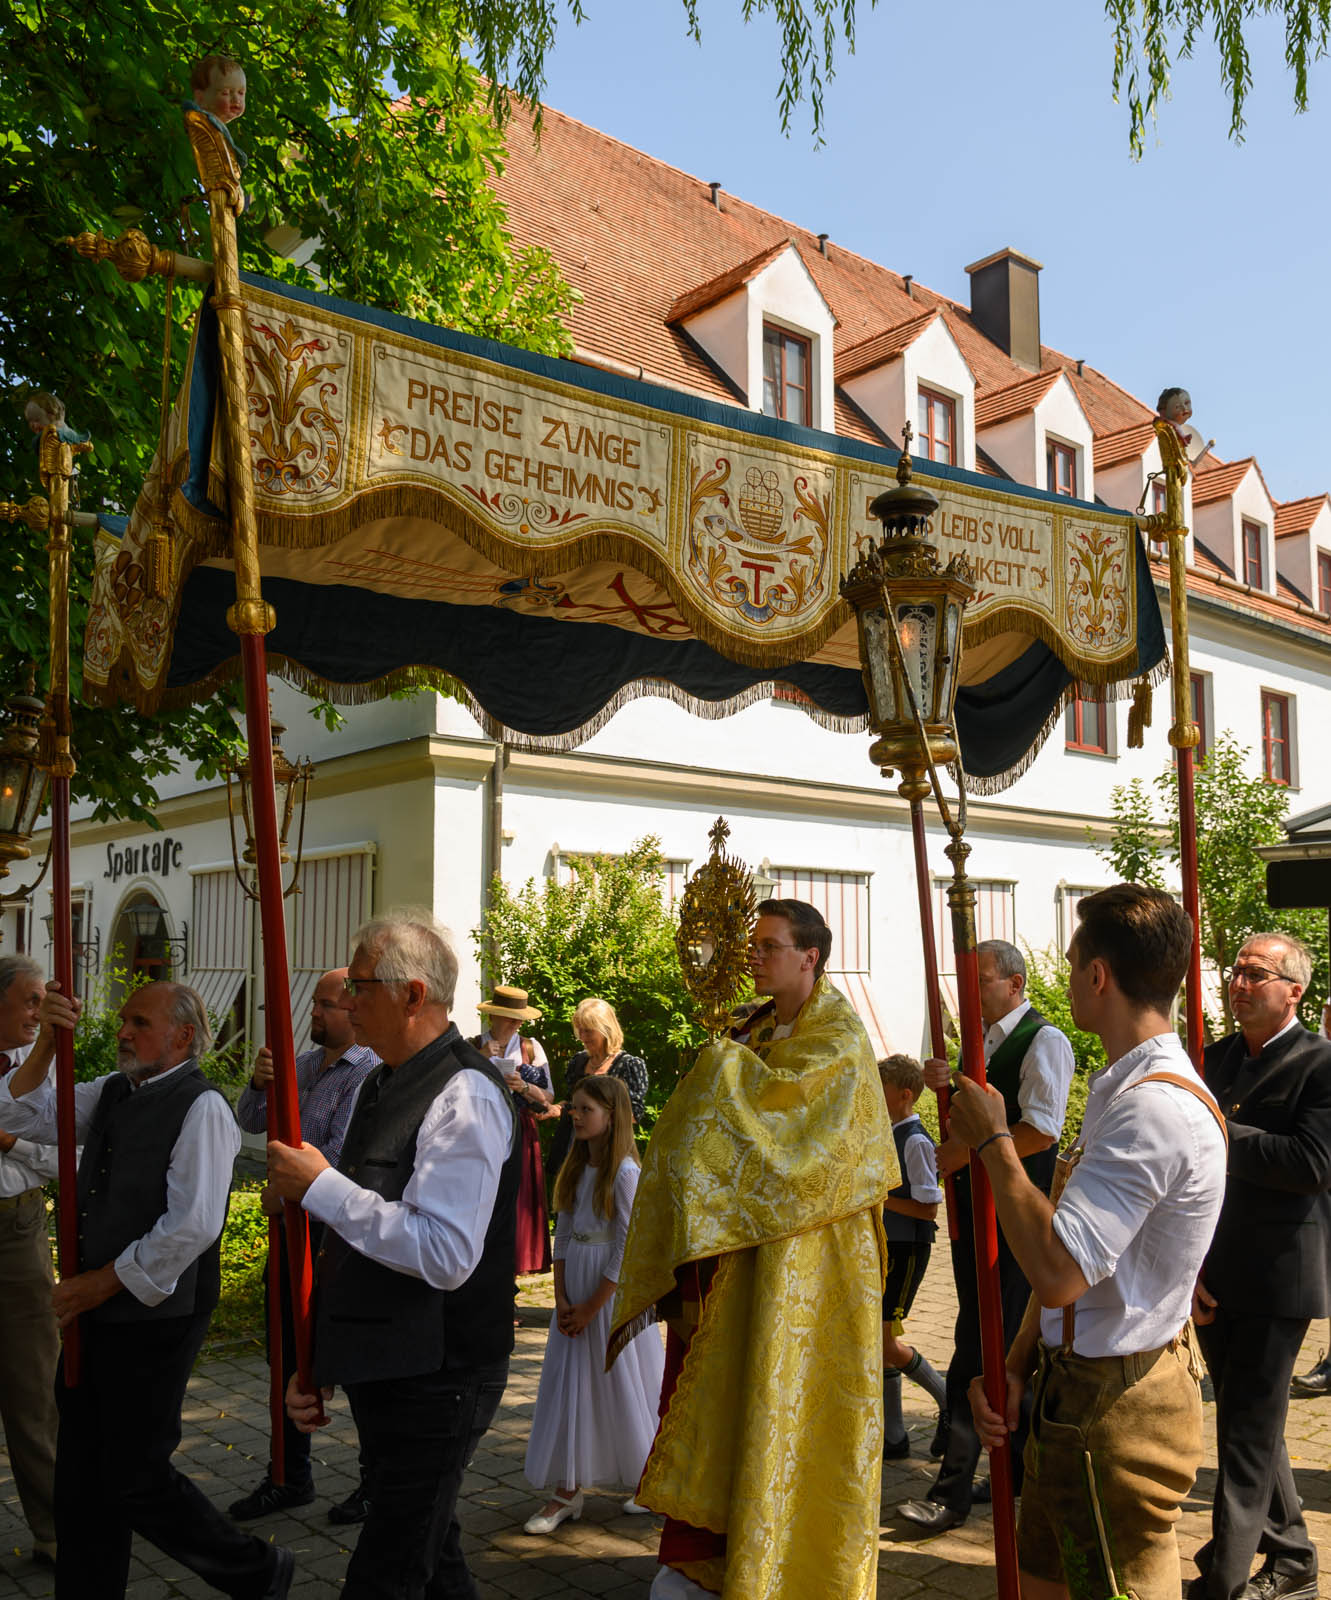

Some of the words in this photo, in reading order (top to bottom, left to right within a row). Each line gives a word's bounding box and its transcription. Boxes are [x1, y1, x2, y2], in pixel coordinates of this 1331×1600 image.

[407, 378, 522, 440] PREISE
[410, 427, 473, 473] DAS
[484, 449, 634, 511] GEHEIMNIS
[941, 511, 993, 545] LEIB'S
[998, 523, 1040, 554] VOLL
